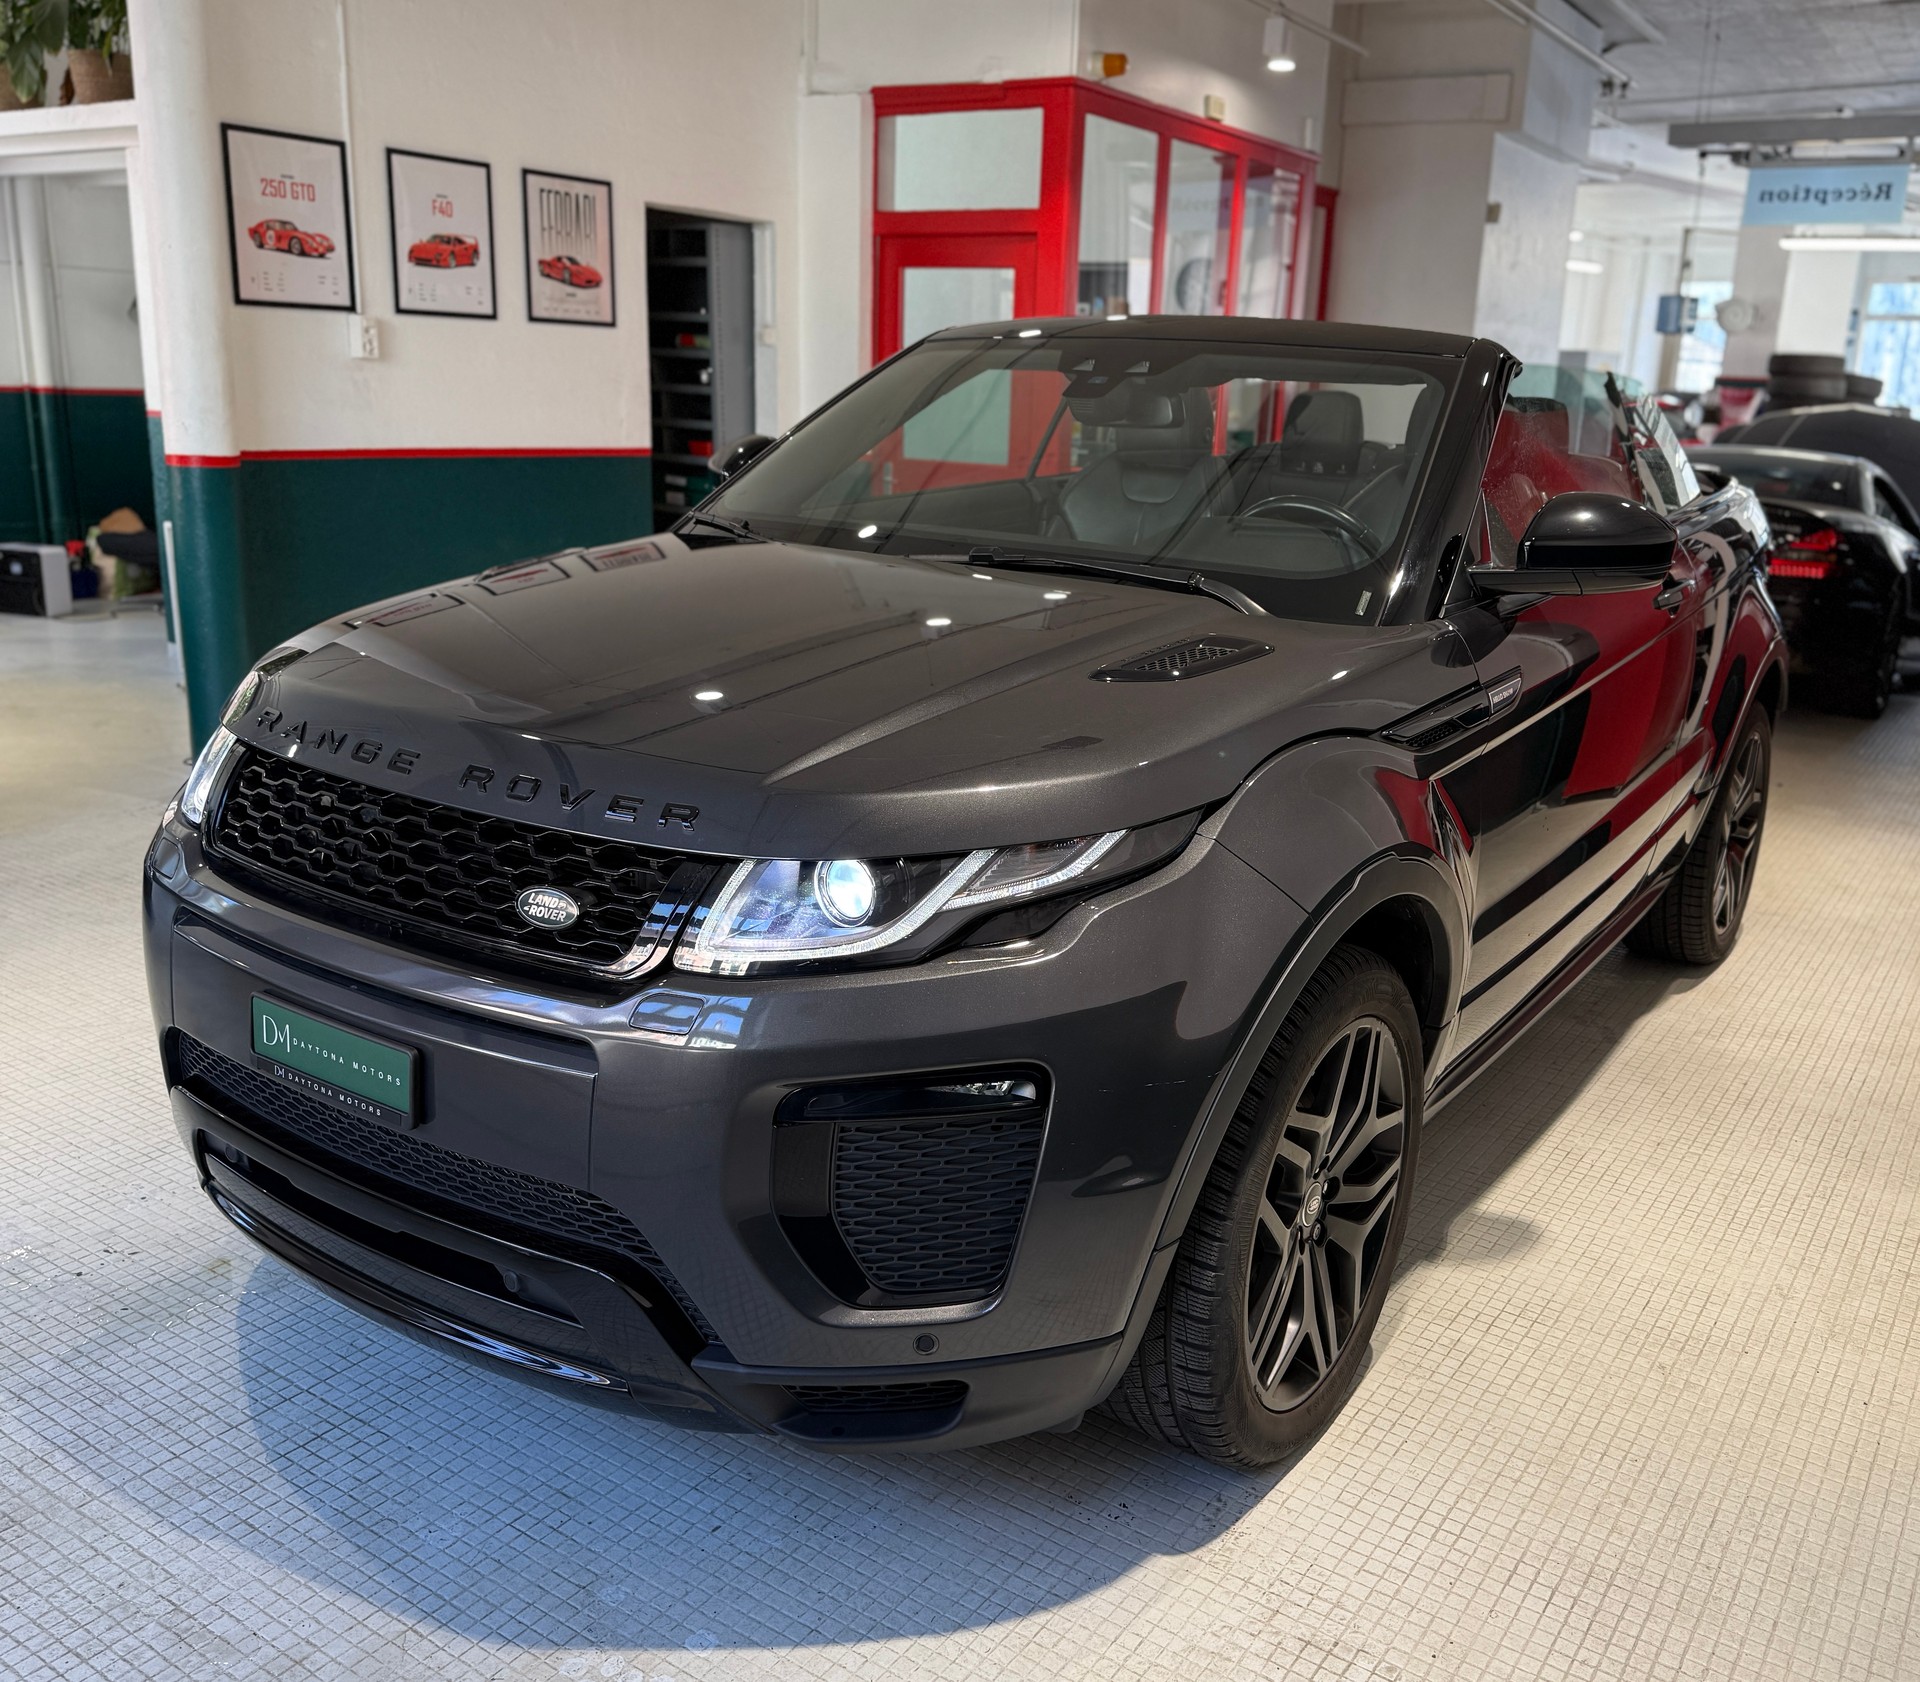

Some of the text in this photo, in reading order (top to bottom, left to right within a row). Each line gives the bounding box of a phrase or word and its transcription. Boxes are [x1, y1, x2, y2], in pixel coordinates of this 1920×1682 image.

[260, 177, 316, 203] 250 GTO
[431, 199, 454, 218] F40
[256, 706, 700, 832] RANGE ROVER
[528, 892, 559, 909] LAND
[528, 904, 567, 922] ROVER
[293, 1037, 344, 1064] DAYTONA
[352, 1061, 401, 1086] MOTORS
[288, 1072, 333, 1097] DAYTONA
[339, 1094, 381, 1116] MOTORS
